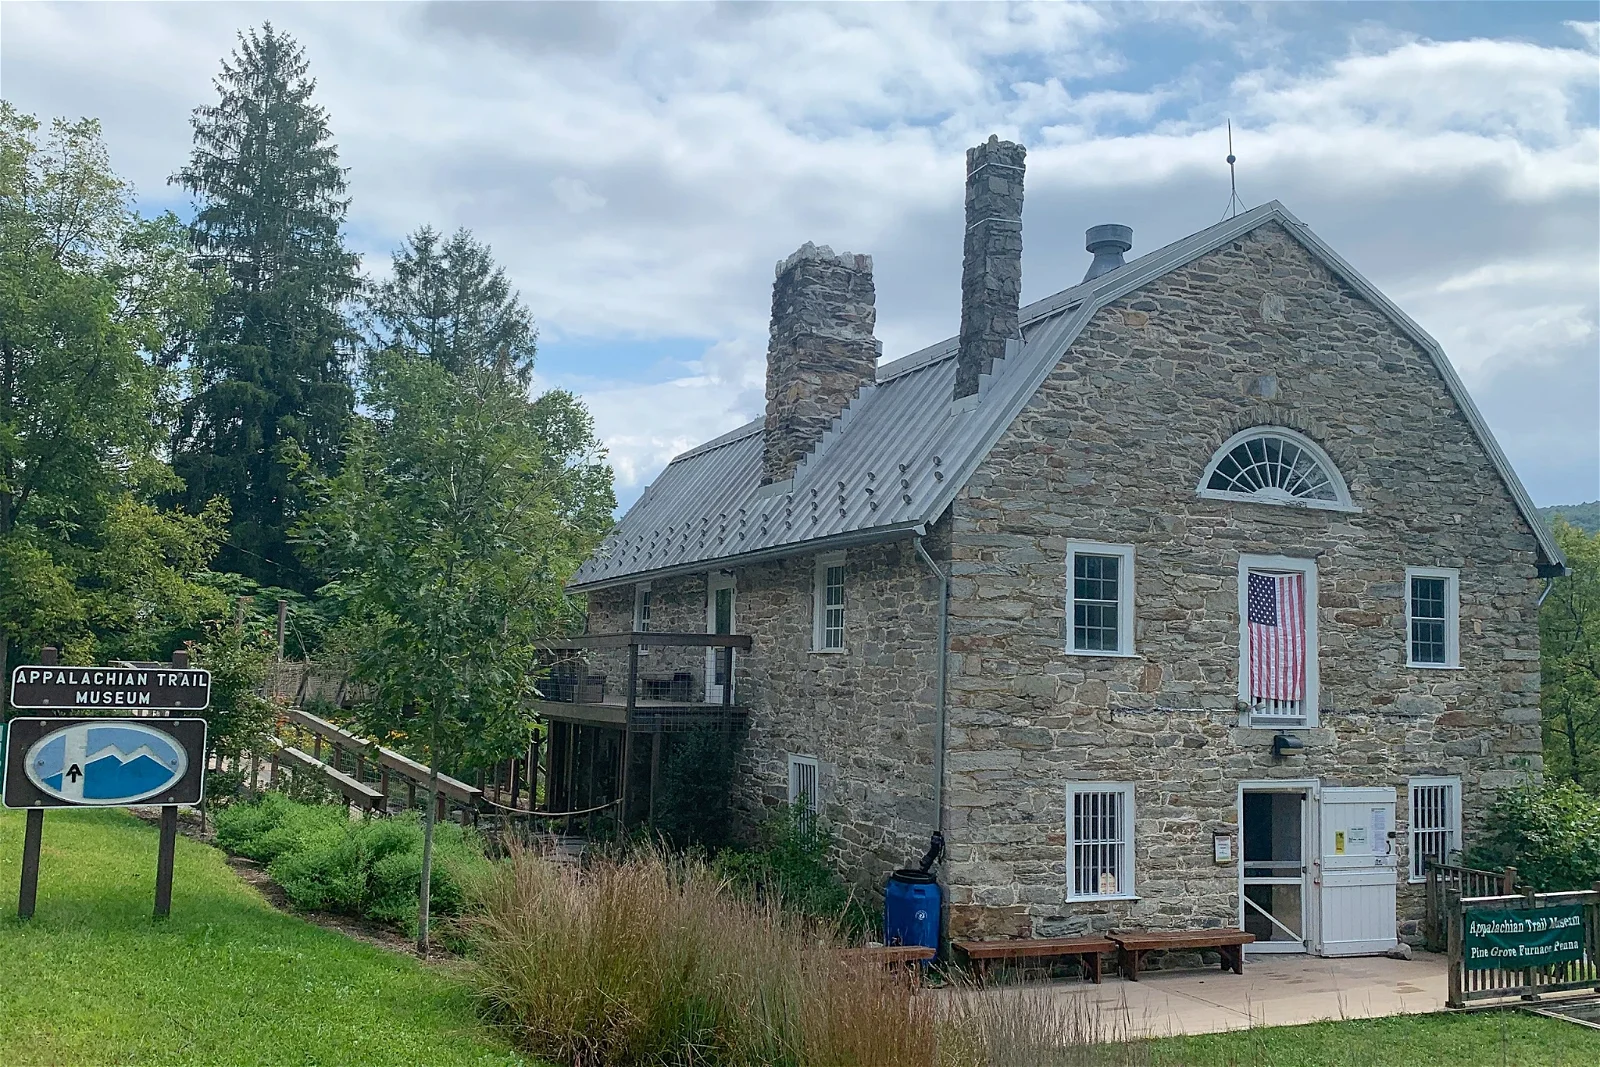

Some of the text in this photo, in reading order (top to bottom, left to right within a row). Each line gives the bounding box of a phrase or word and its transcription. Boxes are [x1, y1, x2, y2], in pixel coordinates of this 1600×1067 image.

[16, 670, 207, 687] APPALACHIAN TRAIL
[75, 690, 151, 705] MUSEUM
[1469, 920, 1524, 937] Appalachian
[1525, 917, 1547, 933] Trail
[1470, 940, 1579, 959] Pine Grove Furnace Penna
